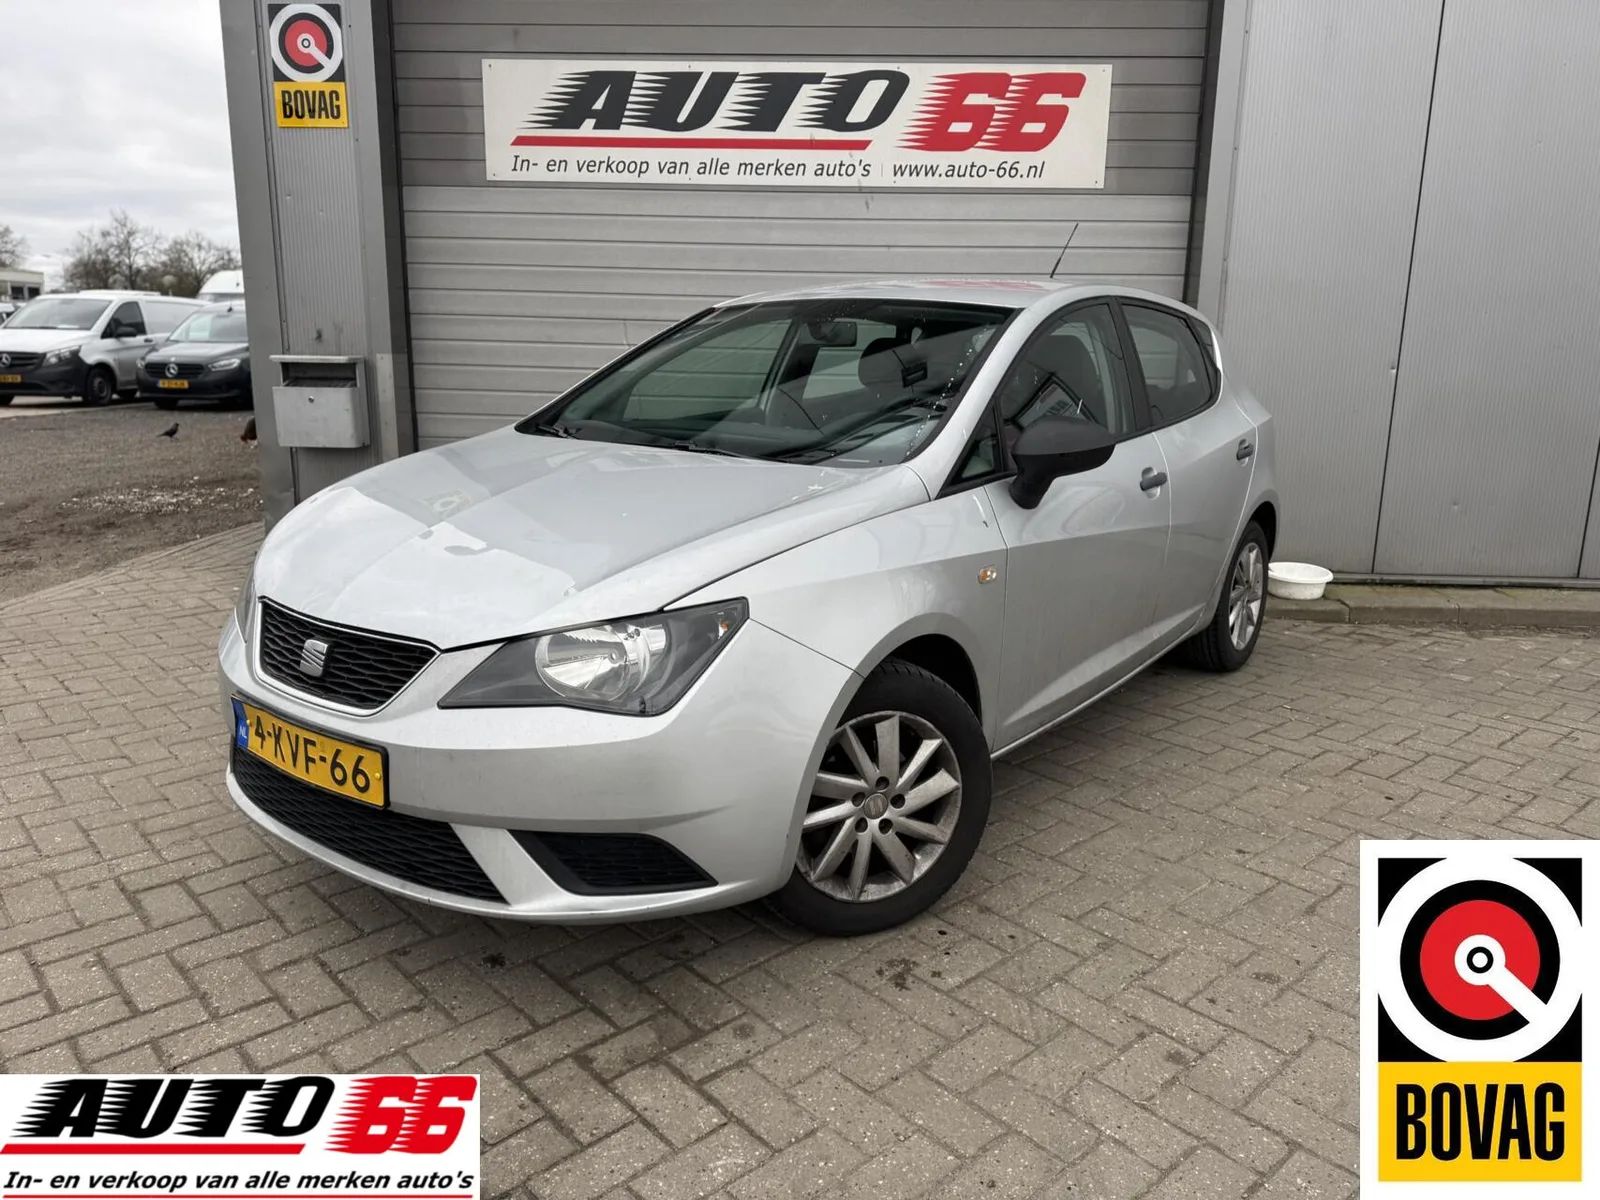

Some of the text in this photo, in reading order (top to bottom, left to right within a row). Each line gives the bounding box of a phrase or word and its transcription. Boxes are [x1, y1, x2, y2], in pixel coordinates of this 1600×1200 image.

[281, 90, 341, 119] BOVAG
[517, 70, 1086, 152] AUTO 66
[511, 155, 872, 178] In- en verkoop van alle merken auto's
[892, 160, 1046, 179] www.auto-66.nl
[239, 726, 248, 739] NL
[254, 715, 371, 794] 4-KVF-66
